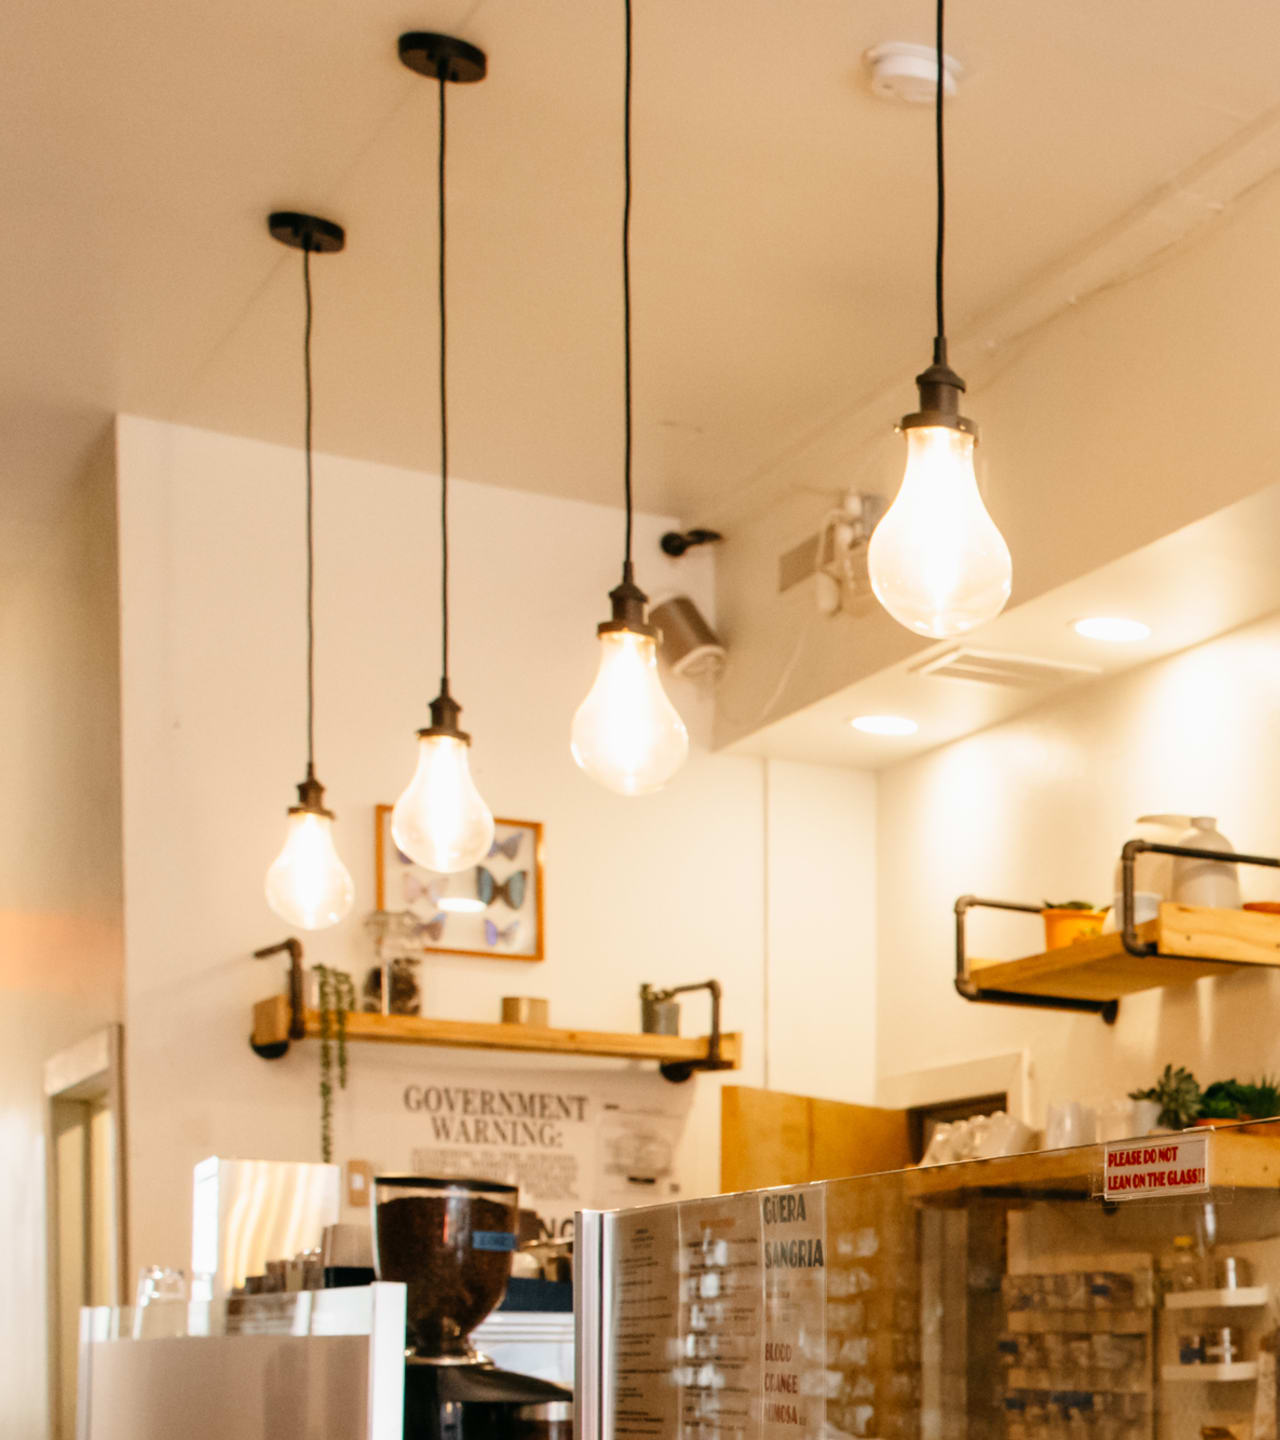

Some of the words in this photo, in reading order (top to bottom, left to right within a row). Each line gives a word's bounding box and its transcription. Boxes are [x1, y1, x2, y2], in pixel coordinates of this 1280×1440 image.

[404, 1085, 588, 1122] GOVERNMENT
[431, 1115, 563, 1148] WARNING:
[1108, 1151, 1141, 1167] PLEASE
[1144, 1149, 1156, 1164] DO
[1159, 1146, 1178, 1162] NOT
[1108, 1175, 1131, 1190] LEAN
[1133, 1174, 1145, 1188] ON
[1147, 1171, 1165, 1187] THE
[1167, 1168, 1205, 1186] GLASS!!
[764, 1238, 823, 1269] SANGRIA
